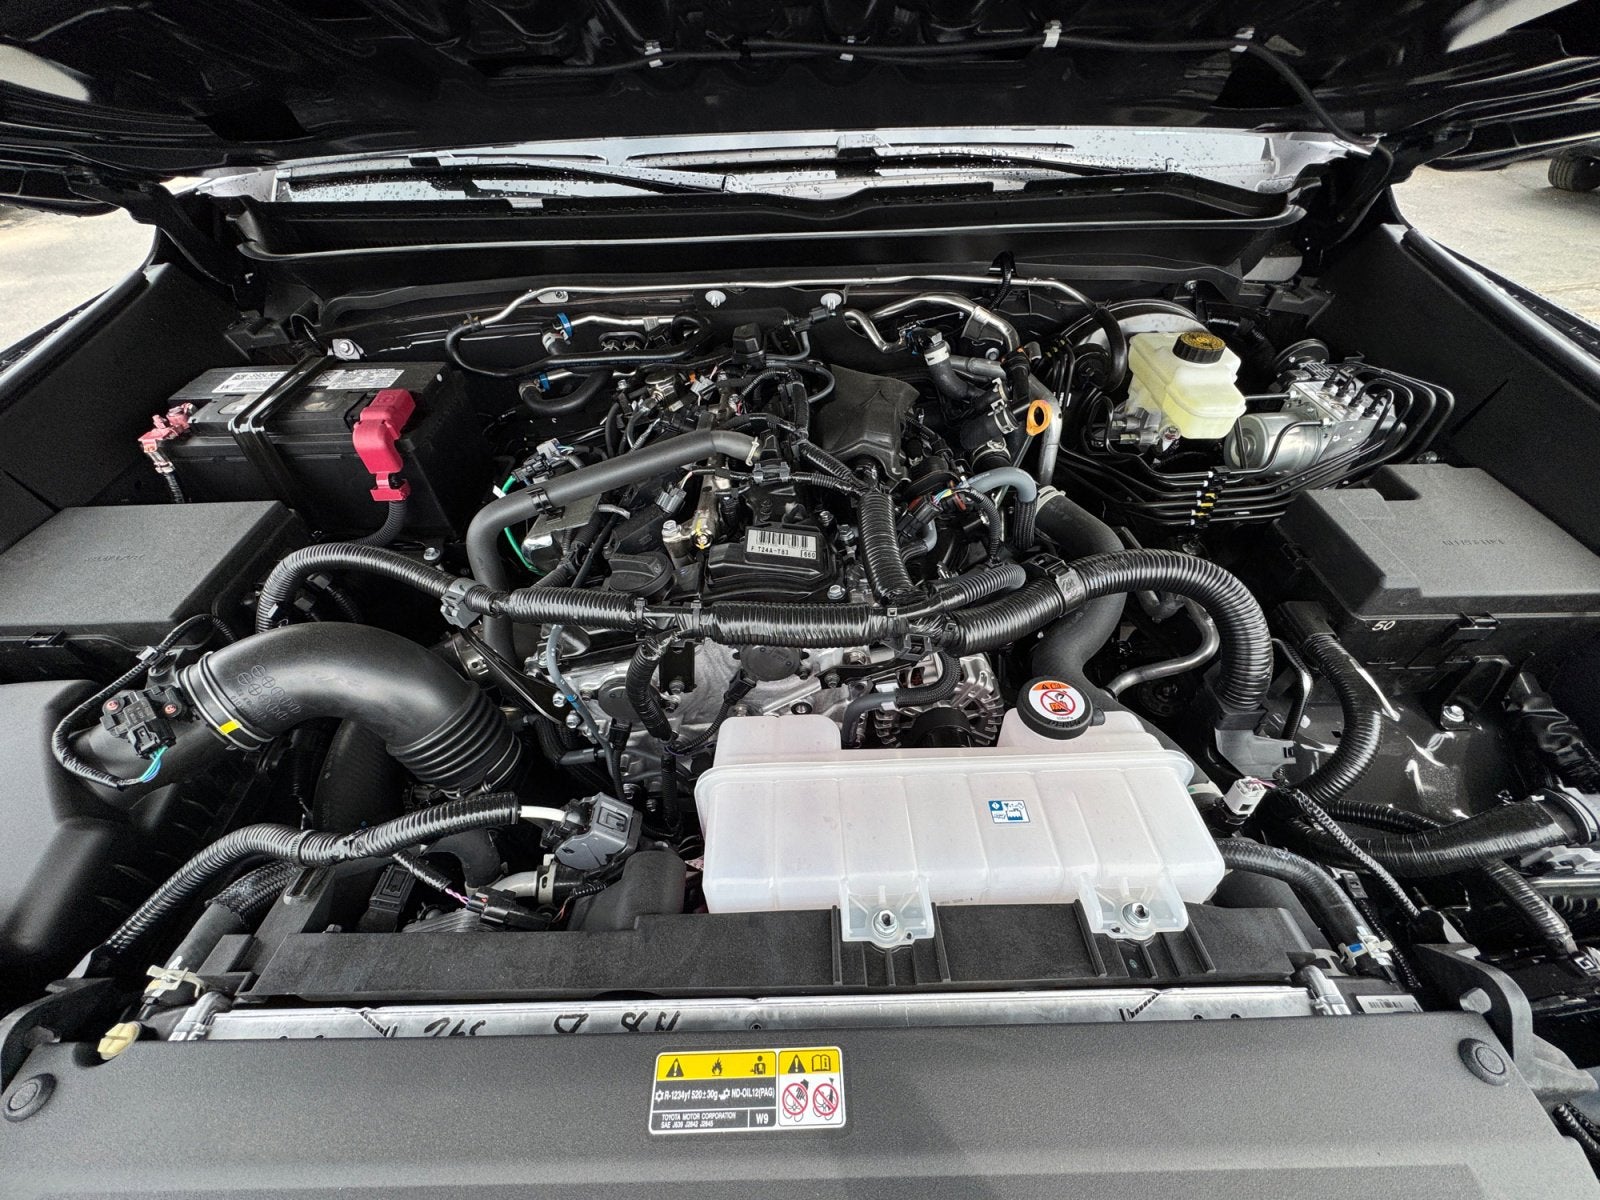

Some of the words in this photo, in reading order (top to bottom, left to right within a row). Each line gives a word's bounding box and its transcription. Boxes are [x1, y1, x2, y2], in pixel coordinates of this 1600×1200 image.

[1371, 620, 1396, 631] 50
[701, 1111, 736, 1120] CORPORATION
[755, 1113, 769, 1125] W9
